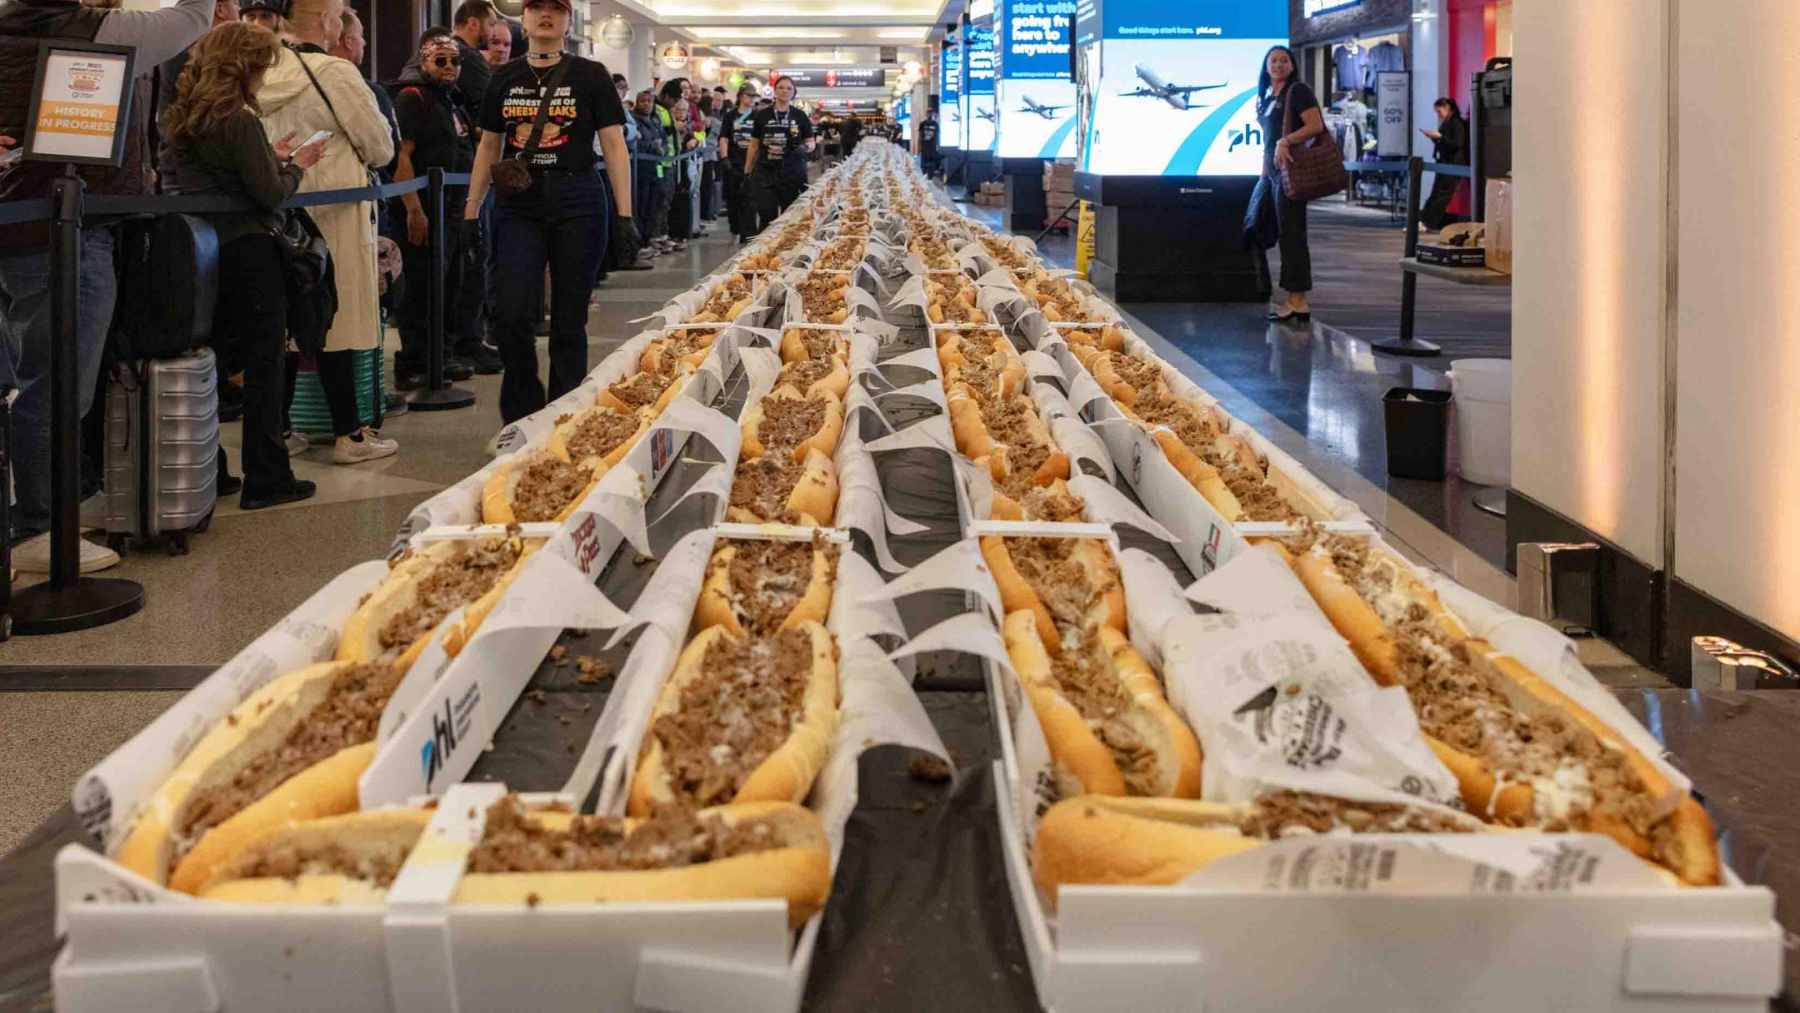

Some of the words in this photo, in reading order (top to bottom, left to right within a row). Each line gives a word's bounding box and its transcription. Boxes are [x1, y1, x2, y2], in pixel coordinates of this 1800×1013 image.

[1012, 2, 1044, 14] start
[1046, 2, 1076, 14] with
[1012, 14, 1051, 31] going
[1012, 28, 1043, 41] here
[1044, 29, 1061, 41] to
[1012, 42, 1070, 57] anywher
[503, 98, 542, 106] LONGEST
[54, 105, 105, 119] HISTORY
[1228, 123, 1262, 152] ph
